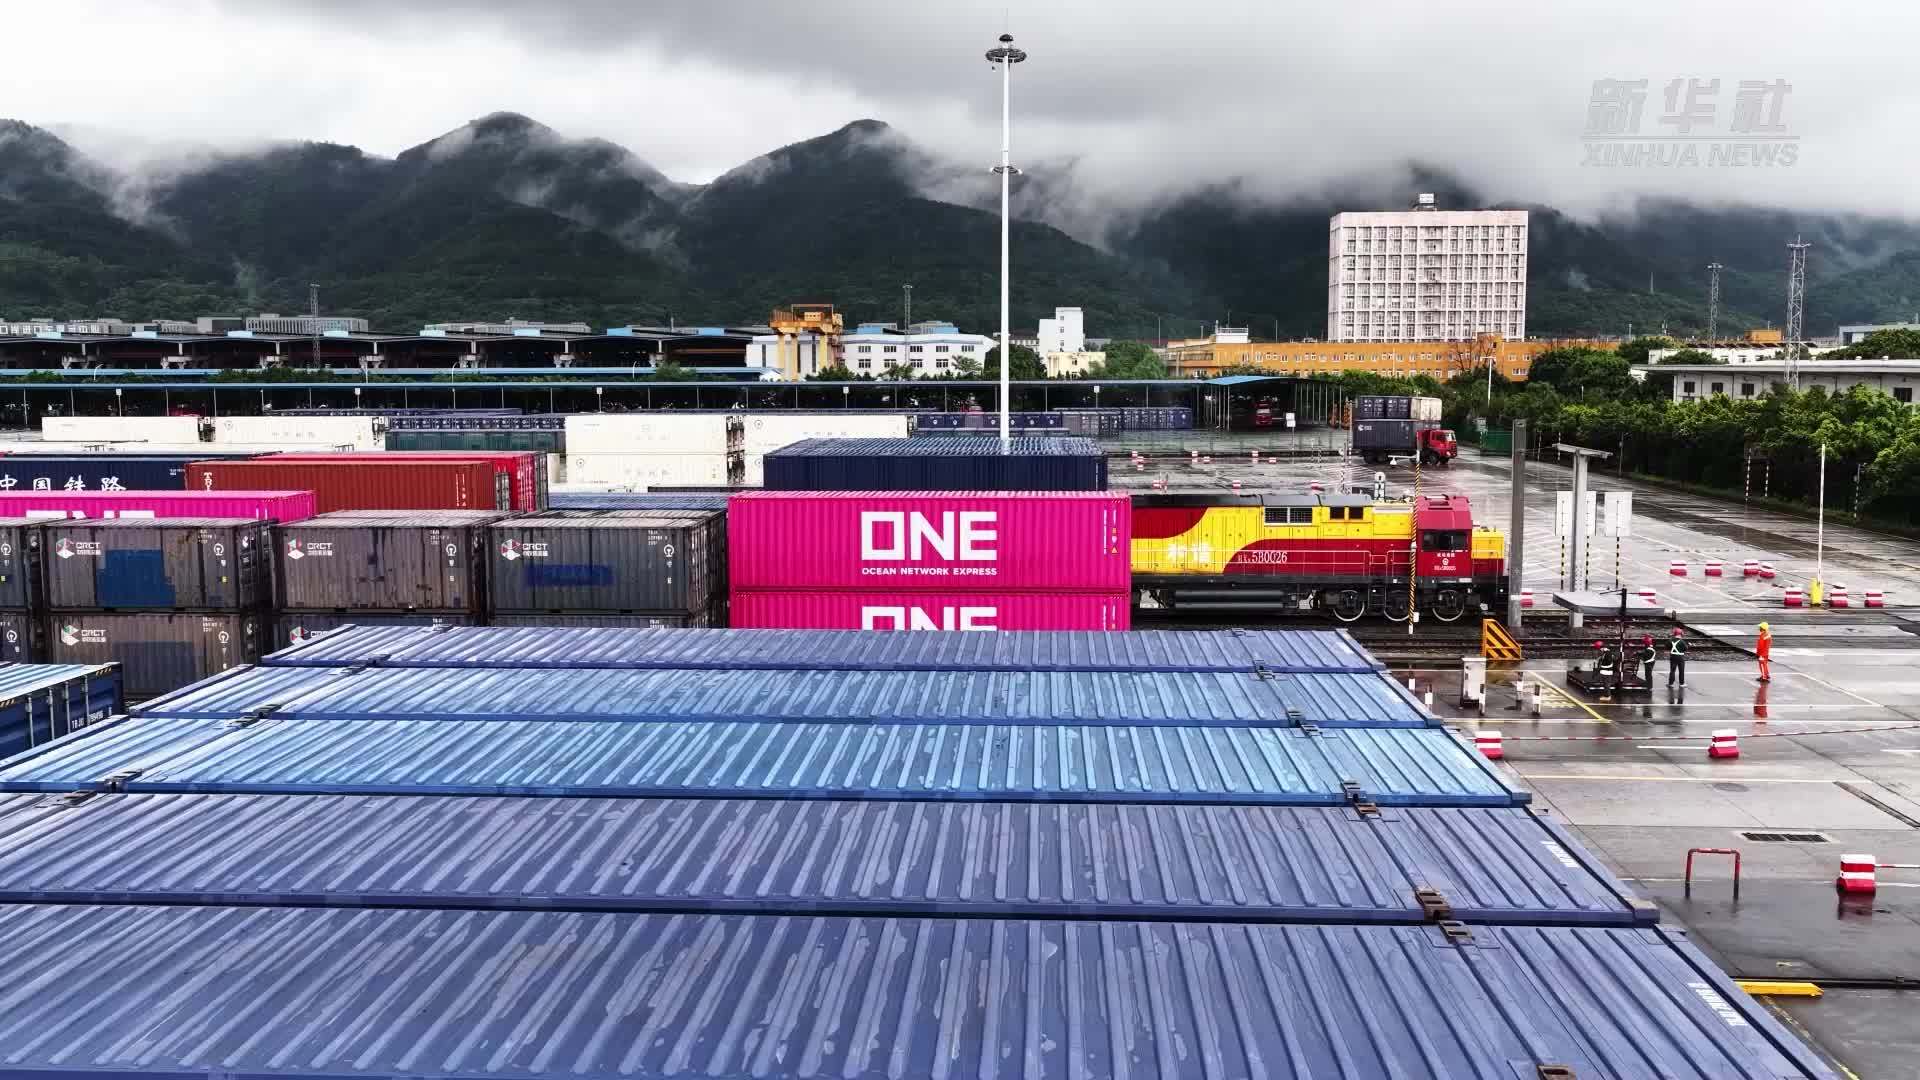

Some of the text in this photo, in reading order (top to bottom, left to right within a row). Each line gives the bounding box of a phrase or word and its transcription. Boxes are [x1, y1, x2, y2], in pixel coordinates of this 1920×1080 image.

[0, 474, 126, 490] 中国铁路
[861, 511, 997, 560] ONE
[862, 567, 997, 576] OCEAN NETWORK EXPRESS
